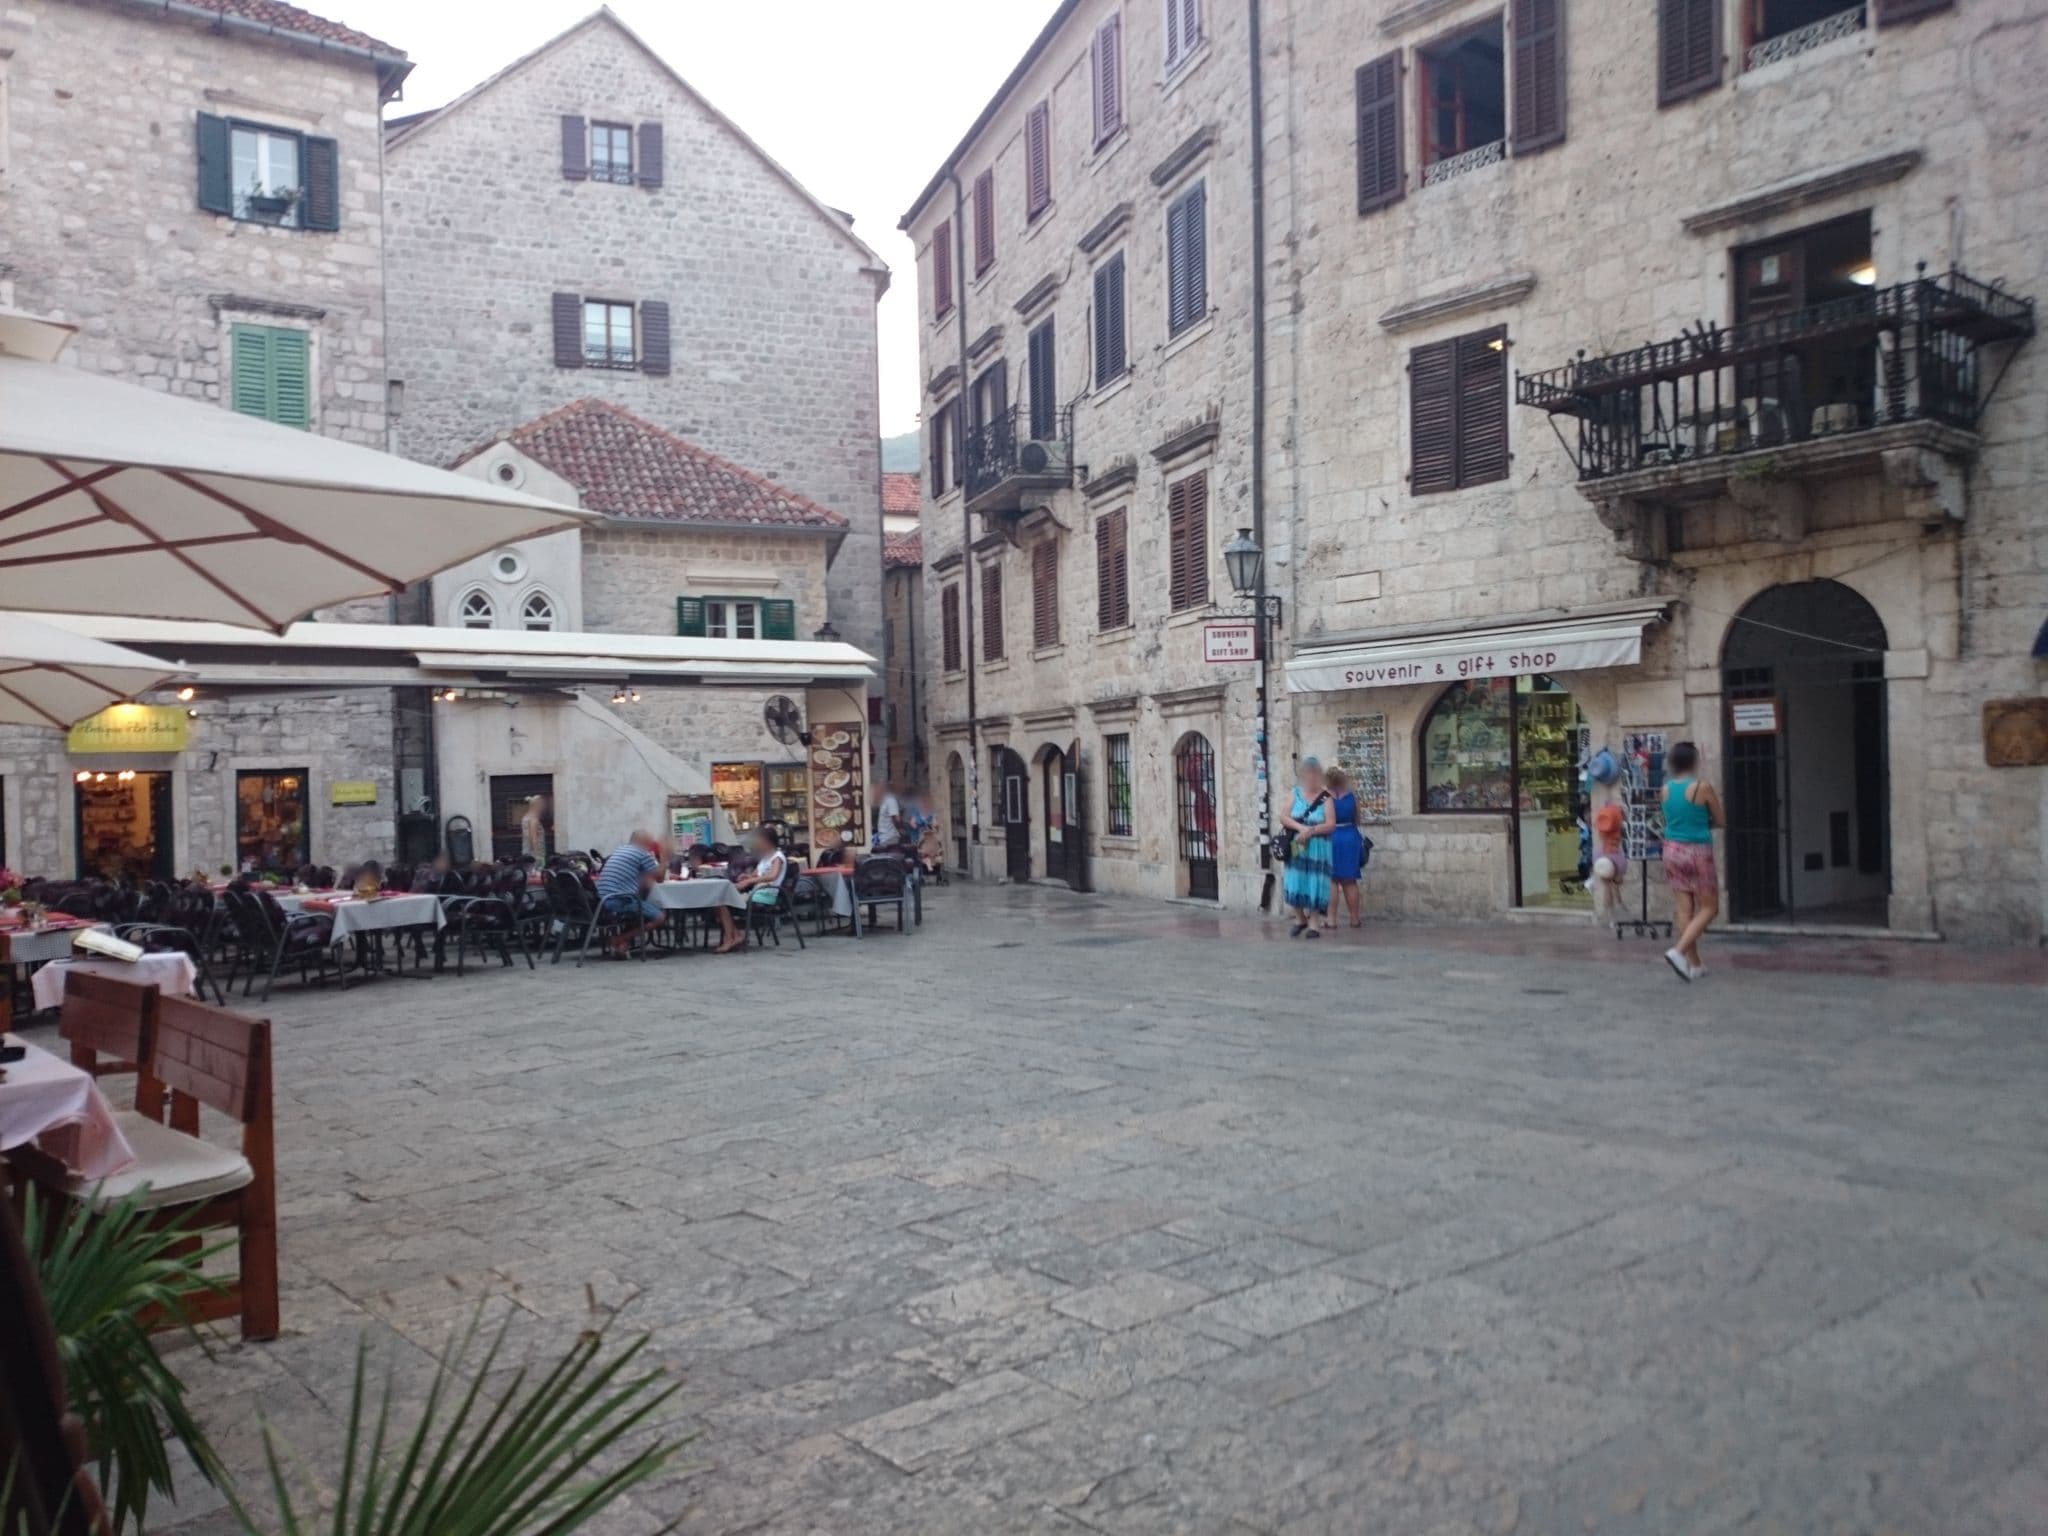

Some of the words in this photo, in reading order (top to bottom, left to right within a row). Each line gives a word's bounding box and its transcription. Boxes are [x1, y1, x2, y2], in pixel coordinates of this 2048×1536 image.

[1212, 630, 1248, 639] SOUVENIR
[1211, 648, 1228, 656] GIFT
[1229, 648, 1249, 656] SHOP
[1345, 663, 1423, 683] souvenir
[1434, 663, 1445, 675] &
[1457, 655, 1496, 676] gift
[1508, 651, 1557, 668] shop
